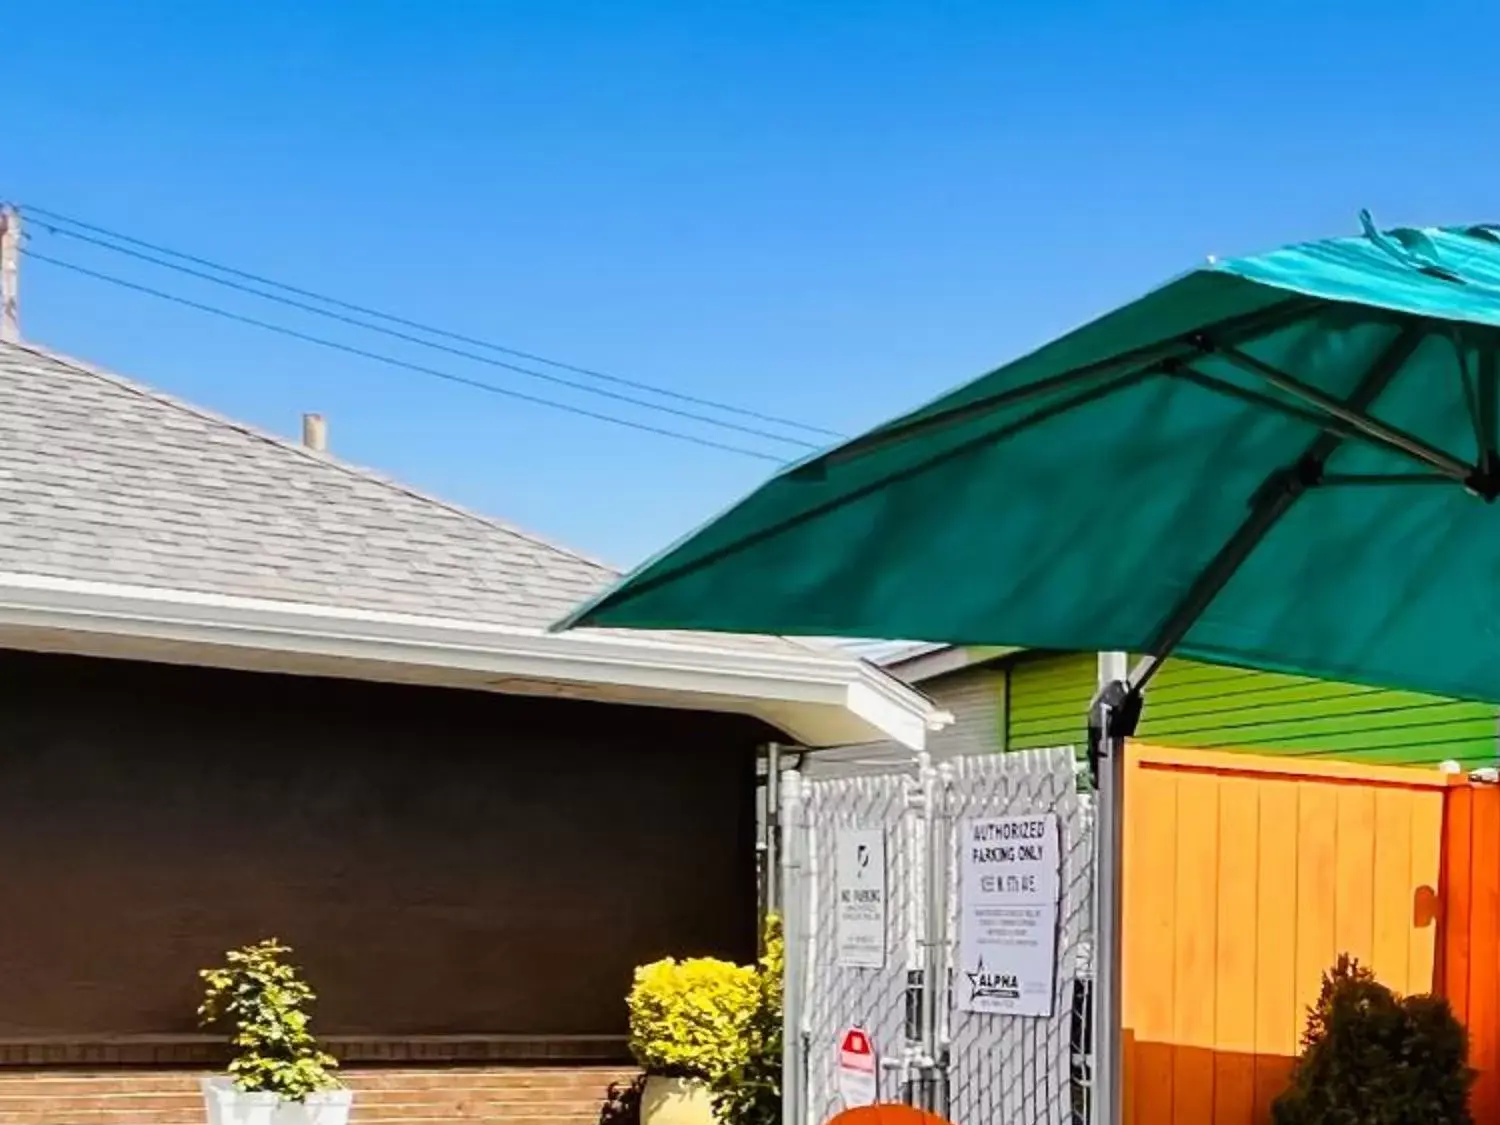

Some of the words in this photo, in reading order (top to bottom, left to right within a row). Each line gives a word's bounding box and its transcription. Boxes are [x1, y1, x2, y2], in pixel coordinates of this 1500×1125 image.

[974, 821, 1046, 842] AUTHORIZED
[973, 846, 1015, 863] PARKING
[1018, 844, 1043, 861] ONLY
[979, 973, 1018, 988] ALPHA
